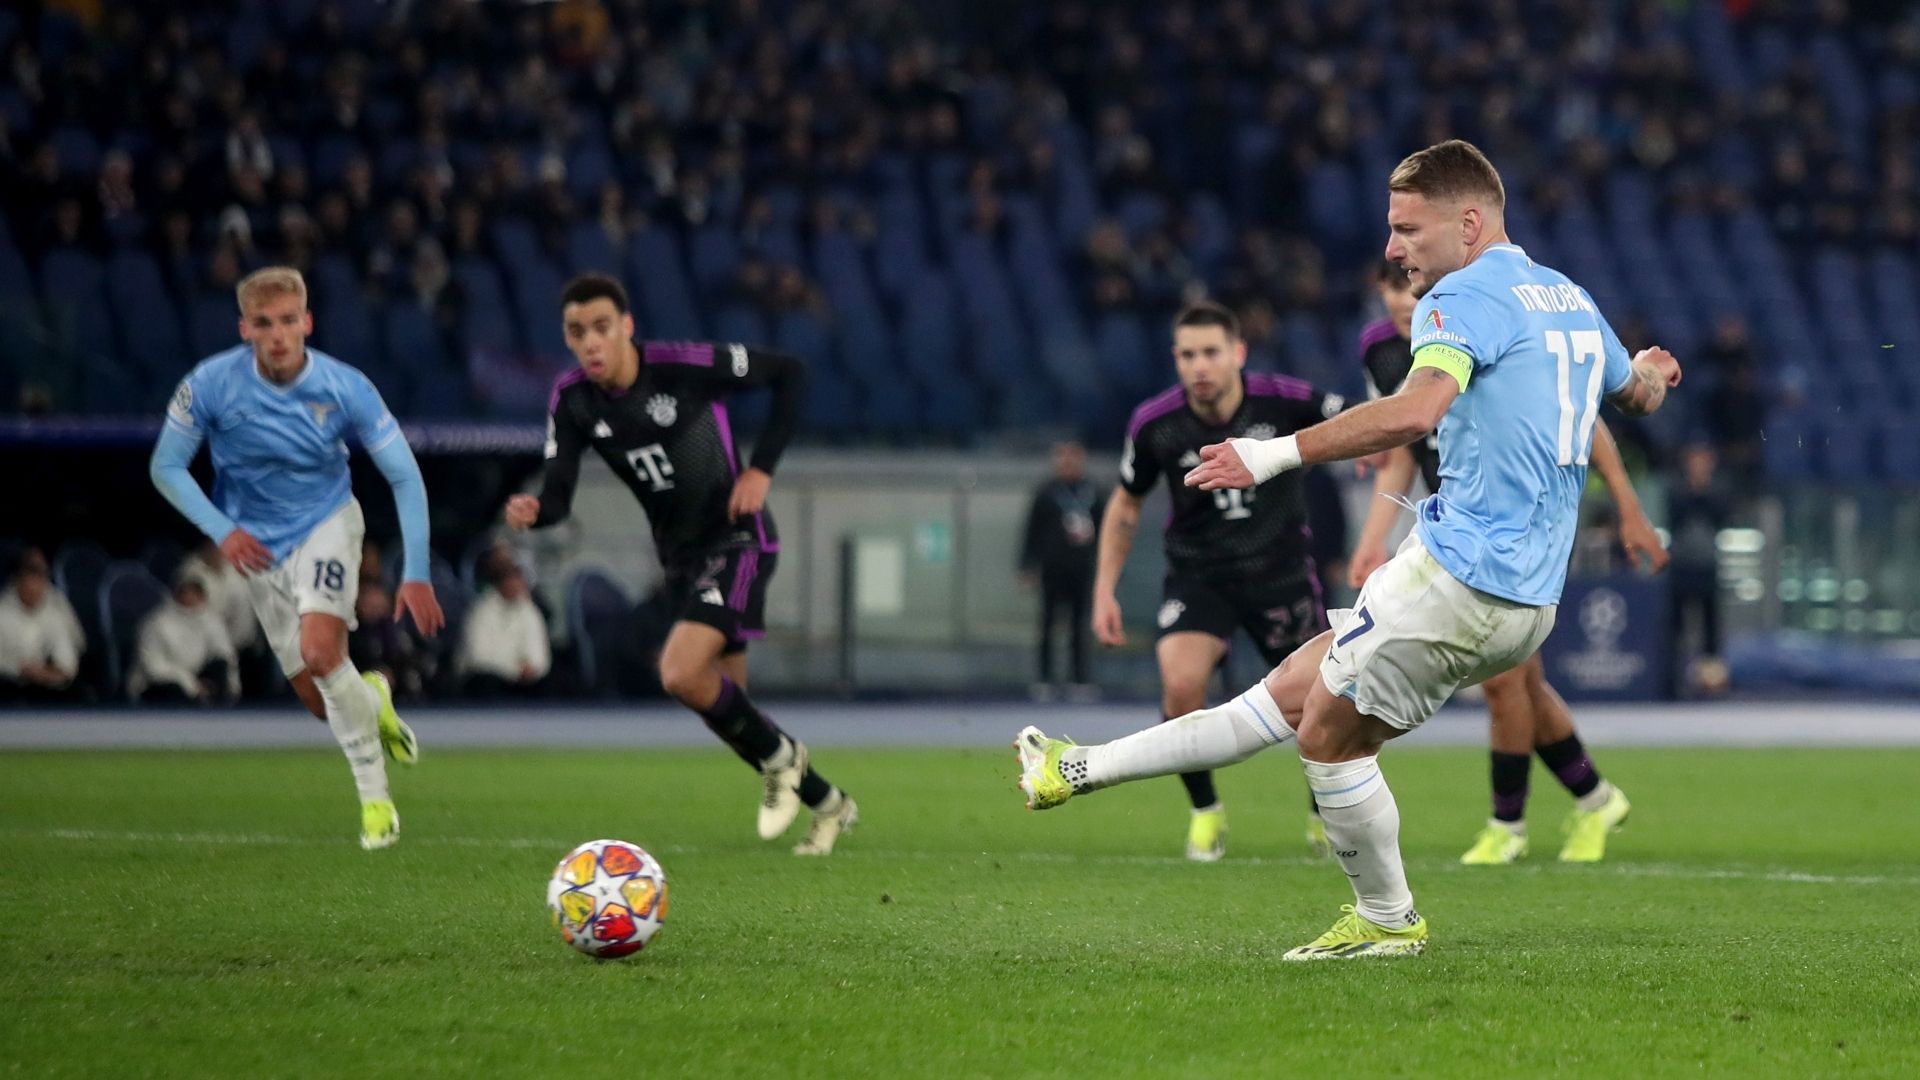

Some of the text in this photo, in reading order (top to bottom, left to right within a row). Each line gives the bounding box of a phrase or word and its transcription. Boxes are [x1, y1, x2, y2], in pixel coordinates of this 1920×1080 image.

[1434, 346, 1469, 370] RESPEC
[1544, 330, 1606, 466] 17
[626, 442, 675, 492] T
[313, 558, 345, 592] 18
